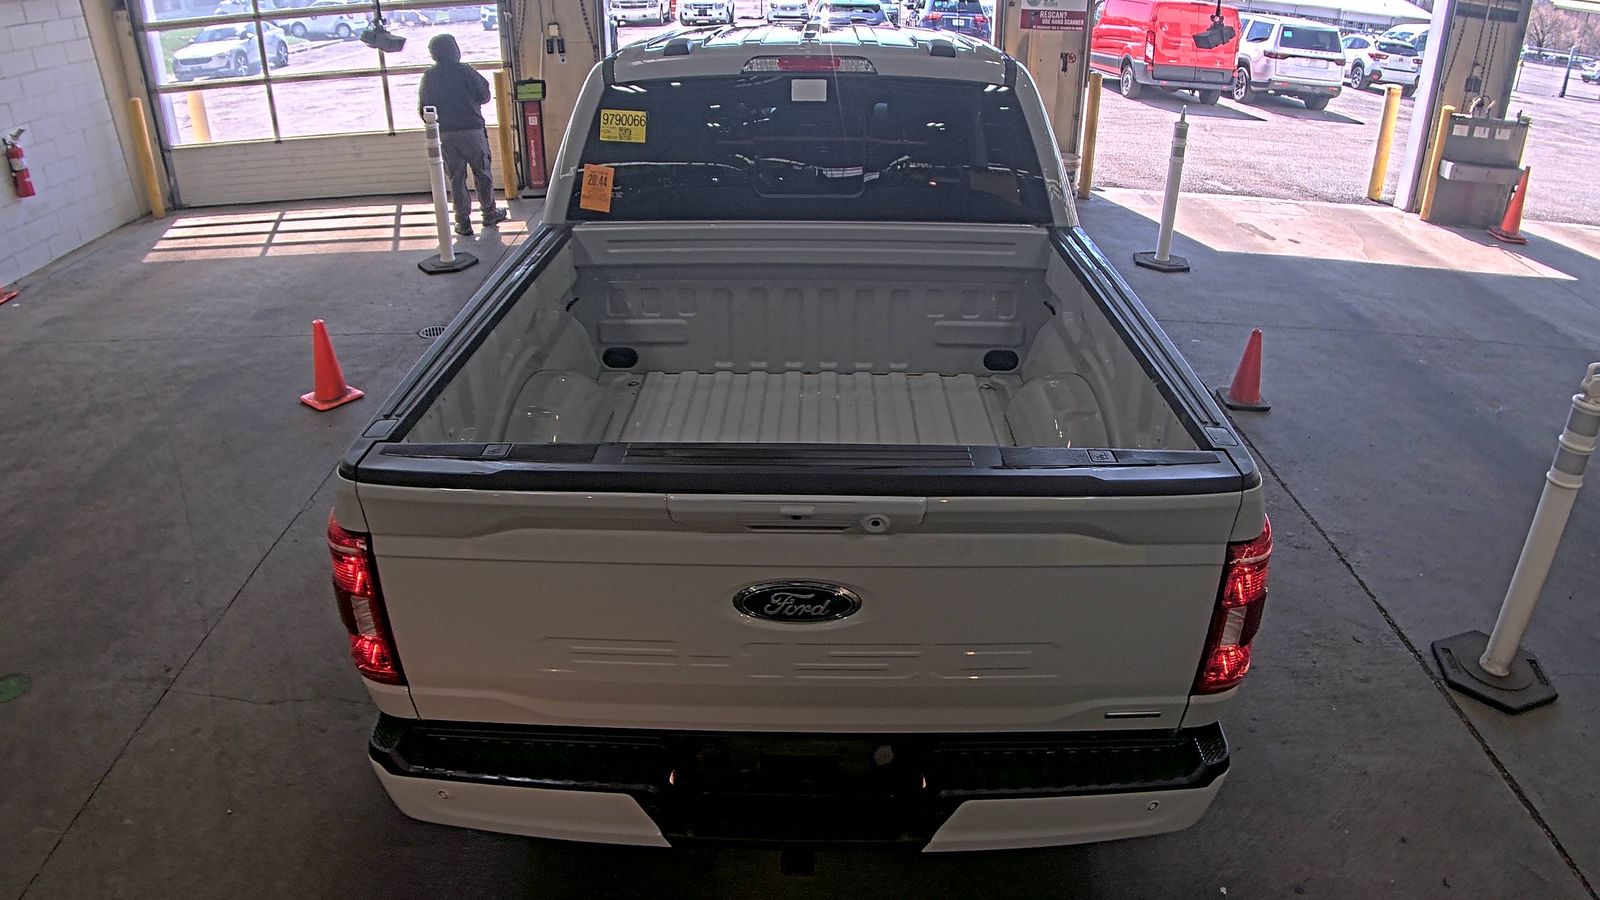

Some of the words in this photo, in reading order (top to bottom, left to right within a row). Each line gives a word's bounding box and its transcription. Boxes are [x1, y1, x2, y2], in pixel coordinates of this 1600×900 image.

[1040, 11, 1067, 19] RESCAN?
[602, 113, 646, 127] 9790066
[764, 592, 831, 616] Ford
